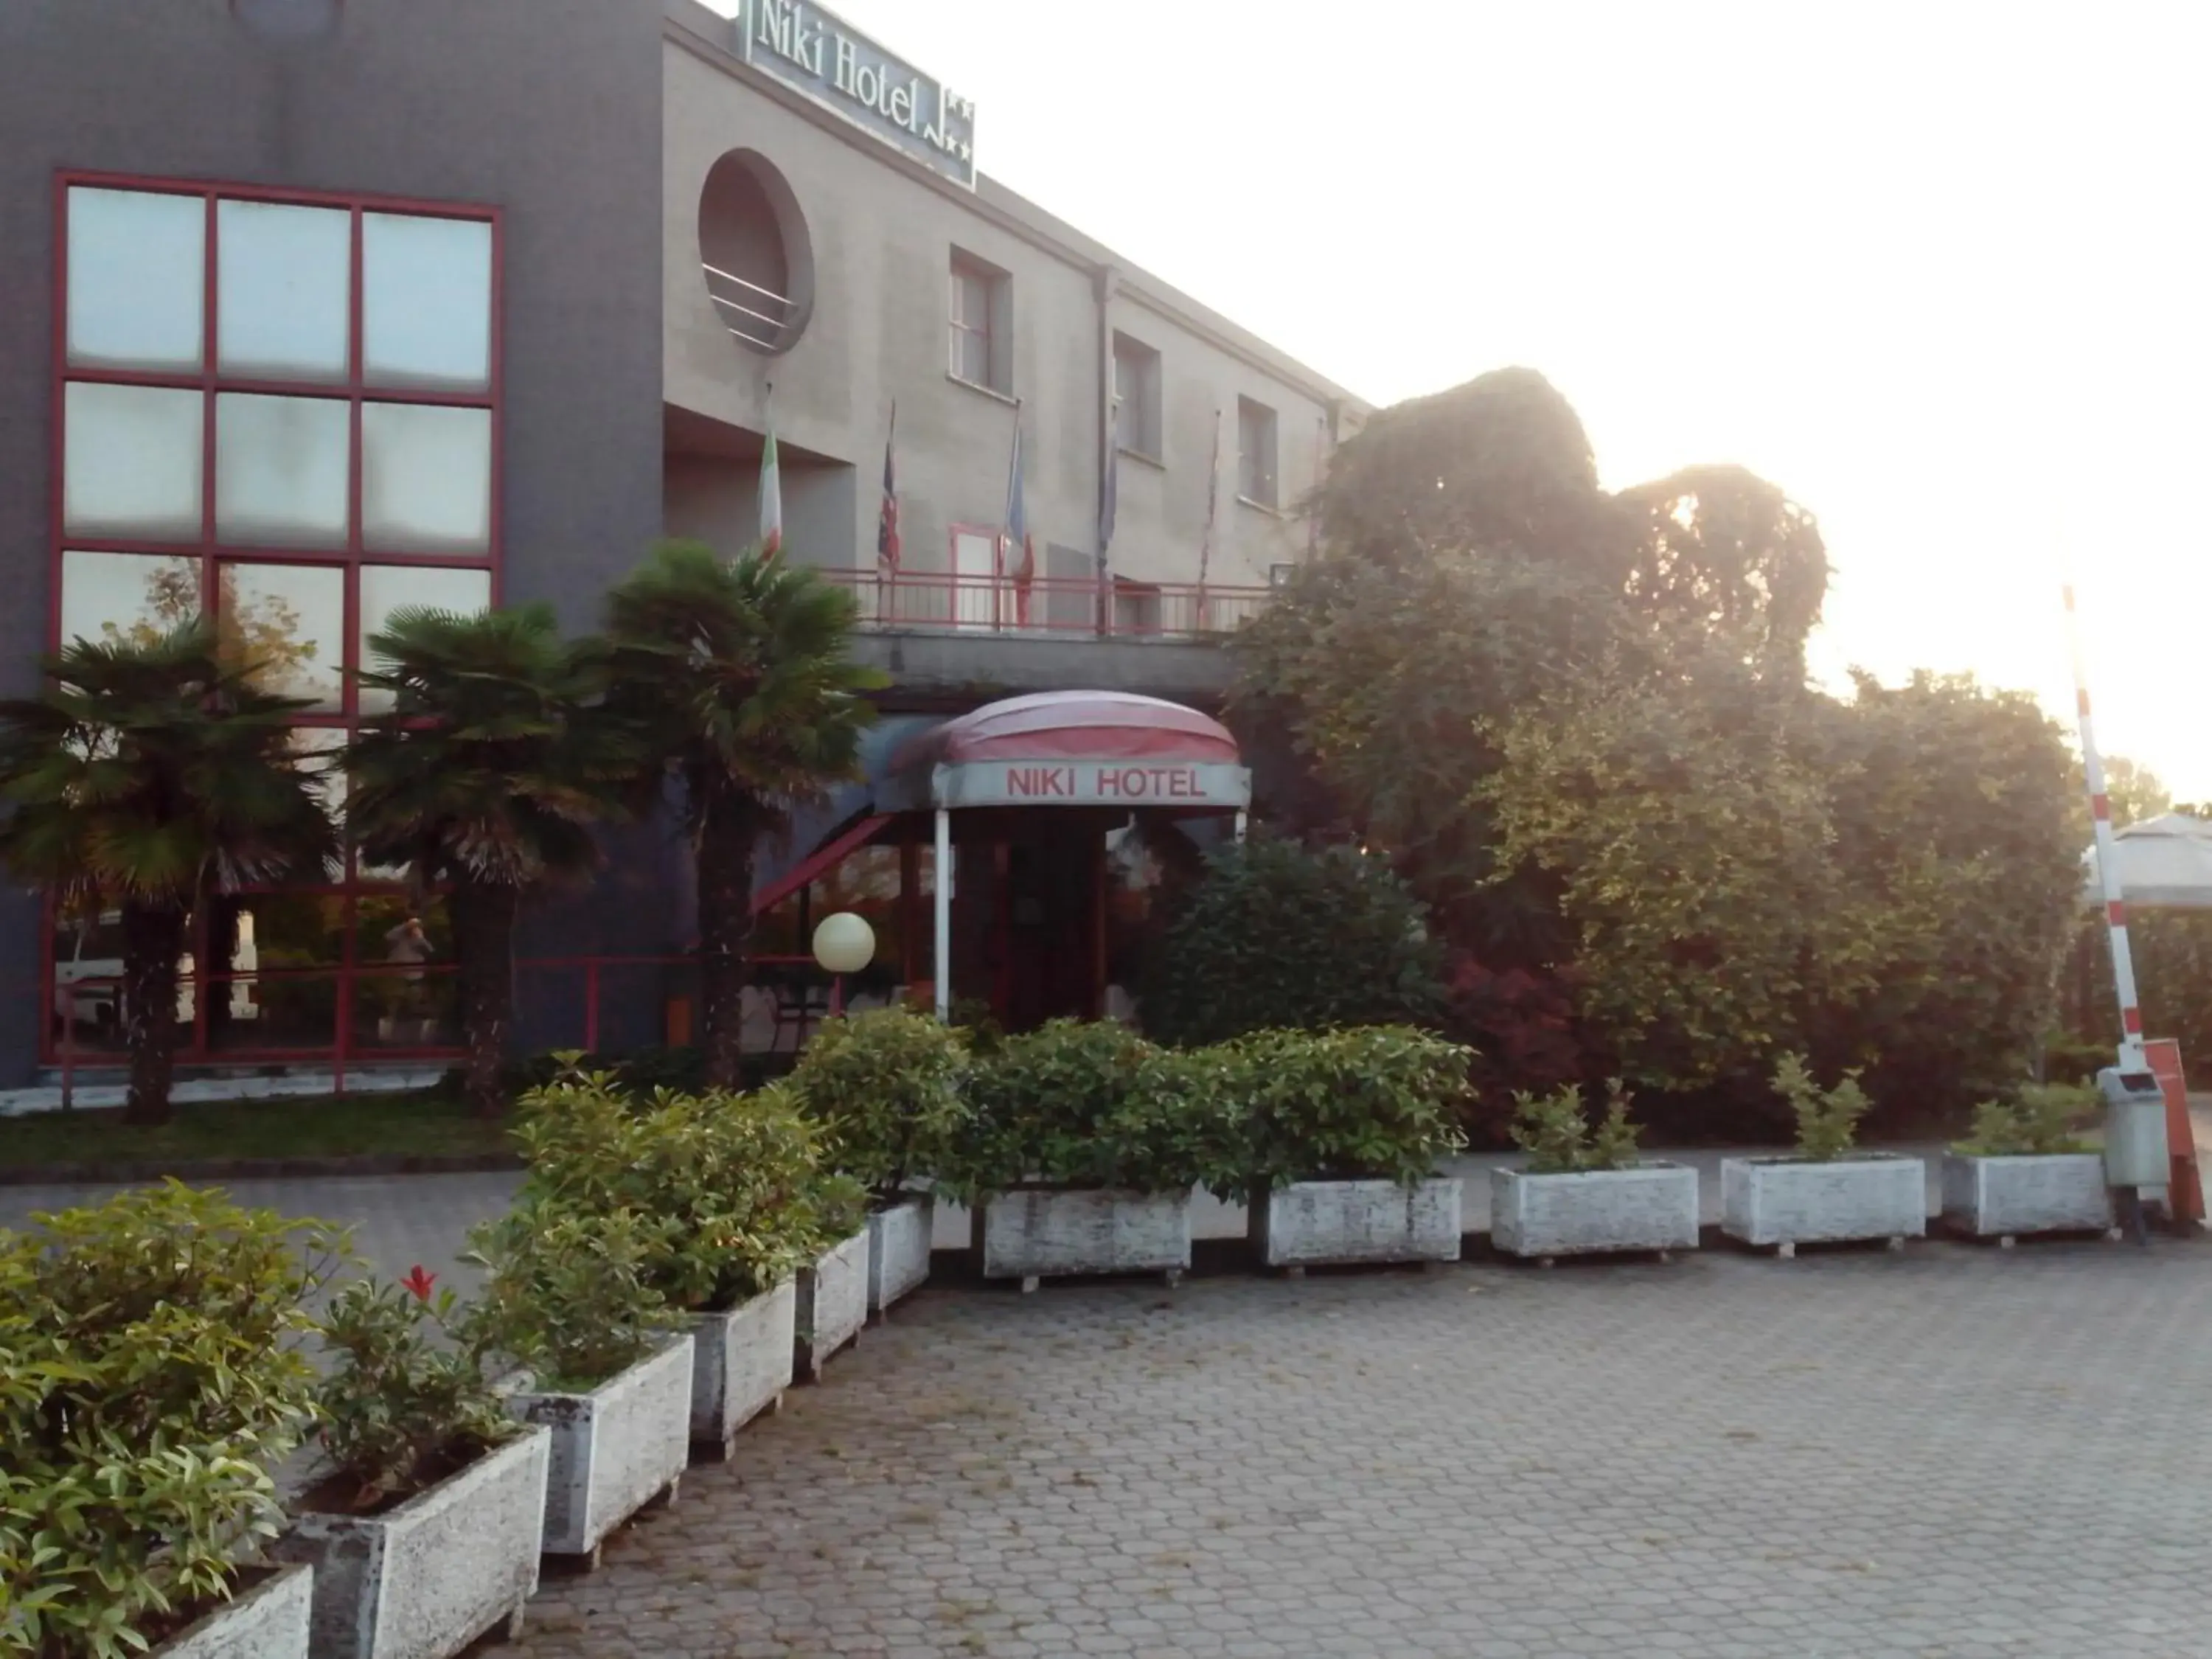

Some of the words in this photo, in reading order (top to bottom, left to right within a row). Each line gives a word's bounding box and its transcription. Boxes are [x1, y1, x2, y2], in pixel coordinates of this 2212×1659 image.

[757, 0, 824, 77] Niki
[834, 32, 919, 133] Hotel
[1006, 768, 1075, 796] NIKI
[1096, 768, 1208, 797] HOTEL
